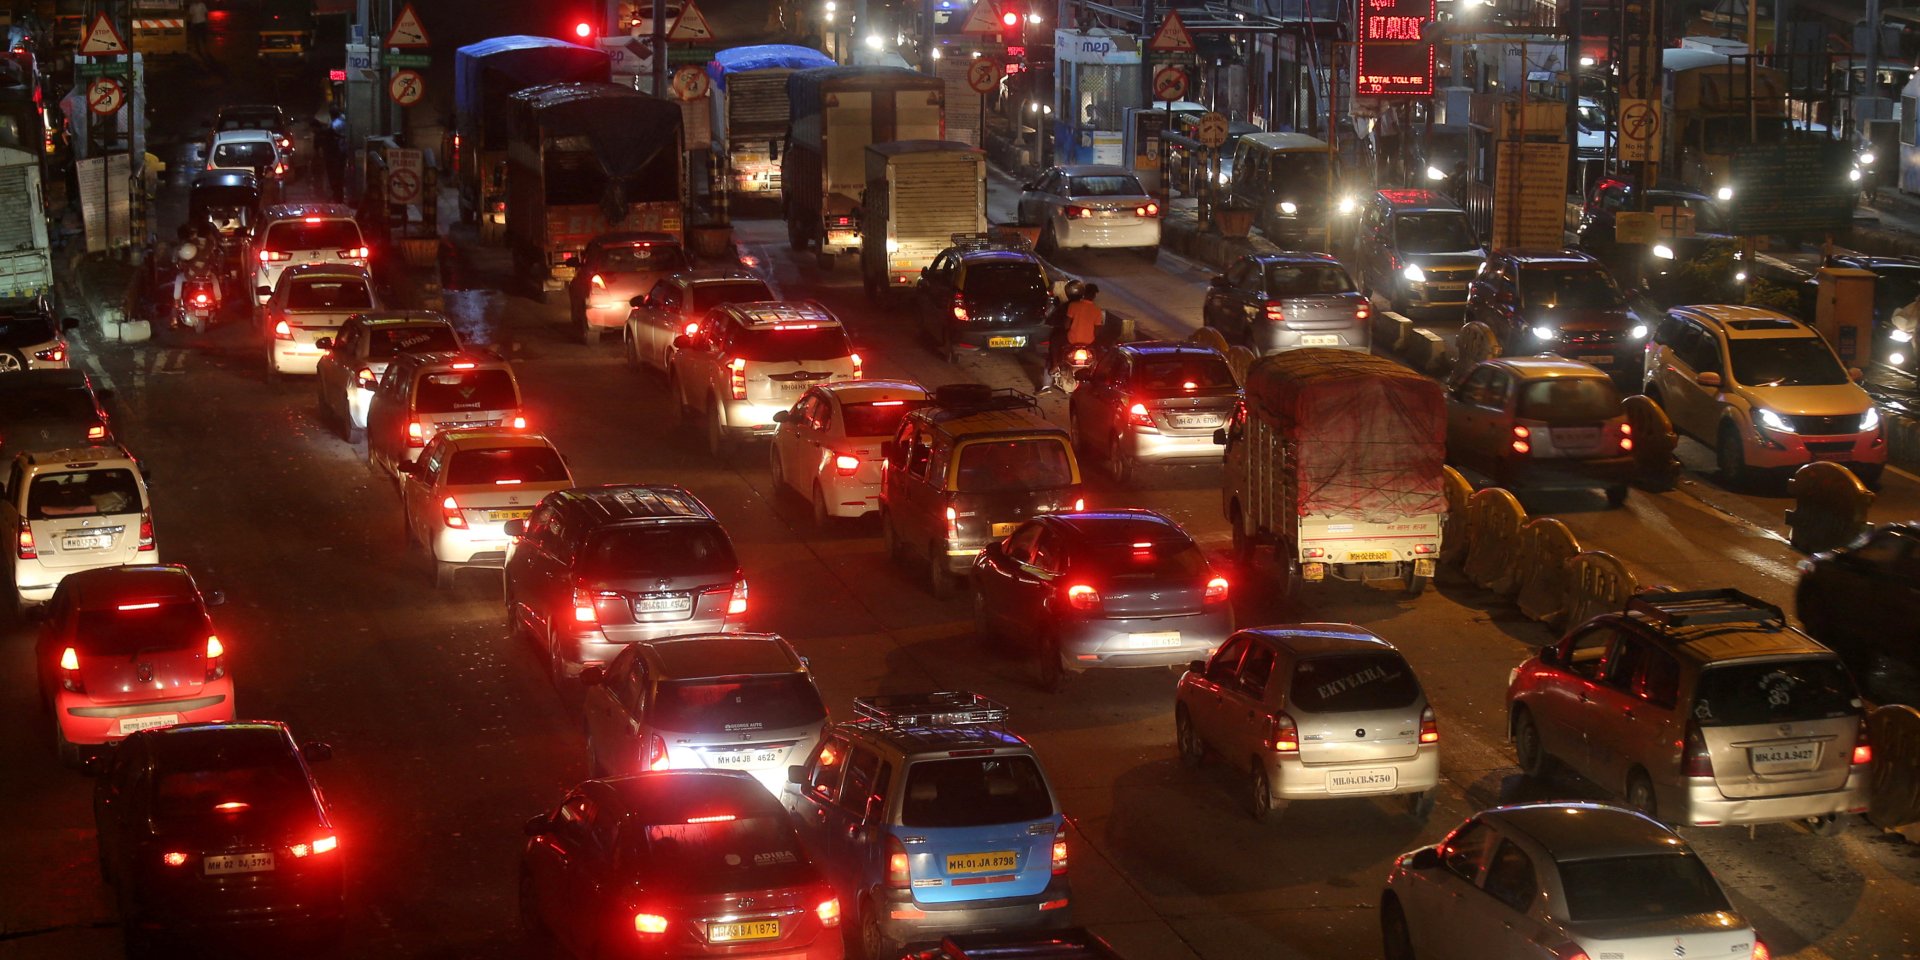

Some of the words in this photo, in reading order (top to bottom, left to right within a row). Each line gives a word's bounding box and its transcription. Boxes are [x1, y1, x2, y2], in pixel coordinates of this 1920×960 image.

[1082, 42, 1110, 56] mep
[609, 50, 624, 64] ep
[1368, 75, 1391, 84] TOTAL
[1392, 75, 1410, 84] TOLL
[1410, 75, 1423, 84] FEE
[1370, 84, 1382, 92] TO
[1317, 665, 1387, 699] EKVEERA
[718, 756, 730, 764] MH
[757, 754, 775, 762] 4622
[754, 850, 794, 863] ADIBA
[208, 862, 221, 870] MH
[224, 861, 233, 869] 02
[755, 923, 778, 935] 1879
